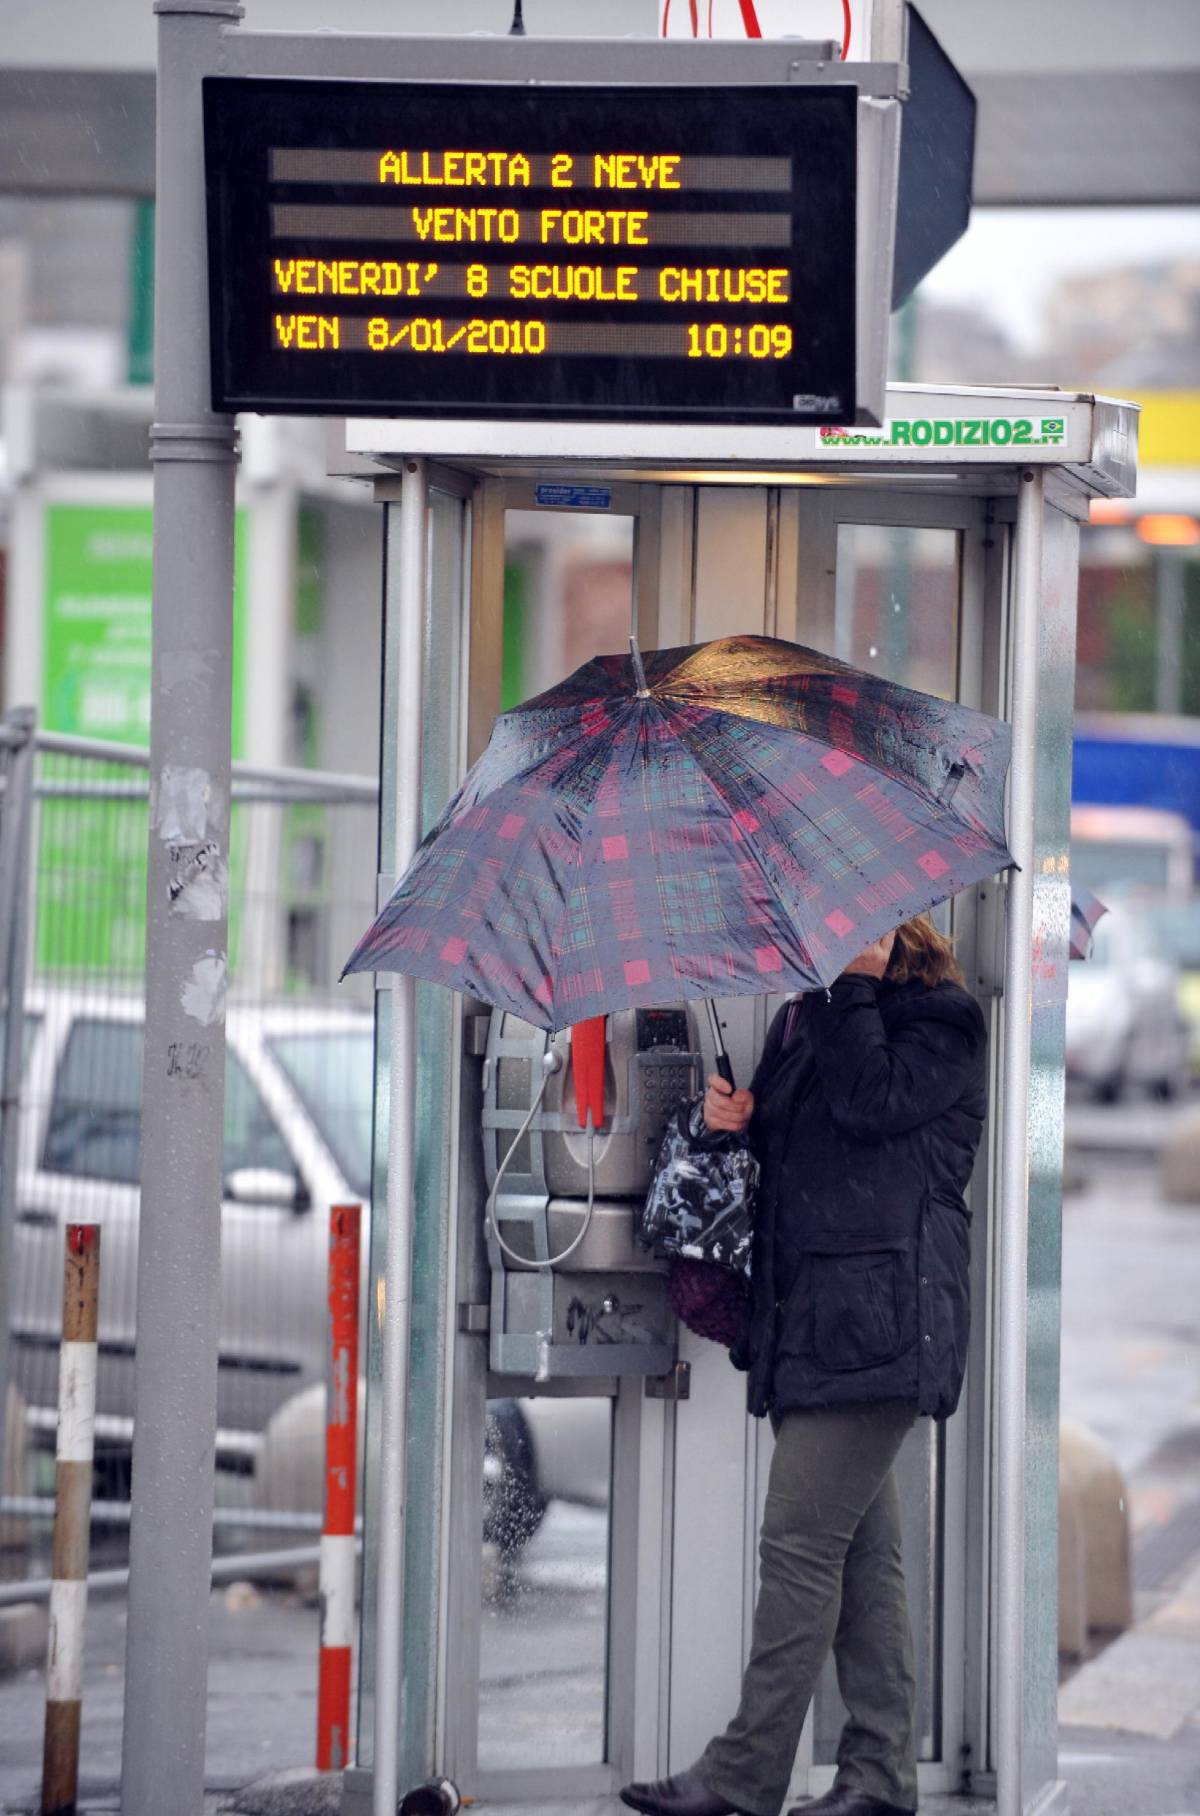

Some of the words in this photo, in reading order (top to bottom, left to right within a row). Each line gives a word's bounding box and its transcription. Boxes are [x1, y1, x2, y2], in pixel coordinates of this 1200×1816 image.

[379, 151, 531, 187] ALLERTA
[552, 154, 574, 188] 2
[594, 154, 681, 189] NEVE
[413, 206, 520, 243] VENTO
[540, 210, 649, 245] FORTE
[274, 259, 438, 296] VENERDI'
[466, 264, 488, 298] 8
[509, 265, 639, 301] SCUOLE
[659, 268, 789, 303] CHIUSE
[275, 315, 340, 349] VEN
[367, 318, 547, 354] 8/01/2010
[687, 323, 793, 359] 10:09
